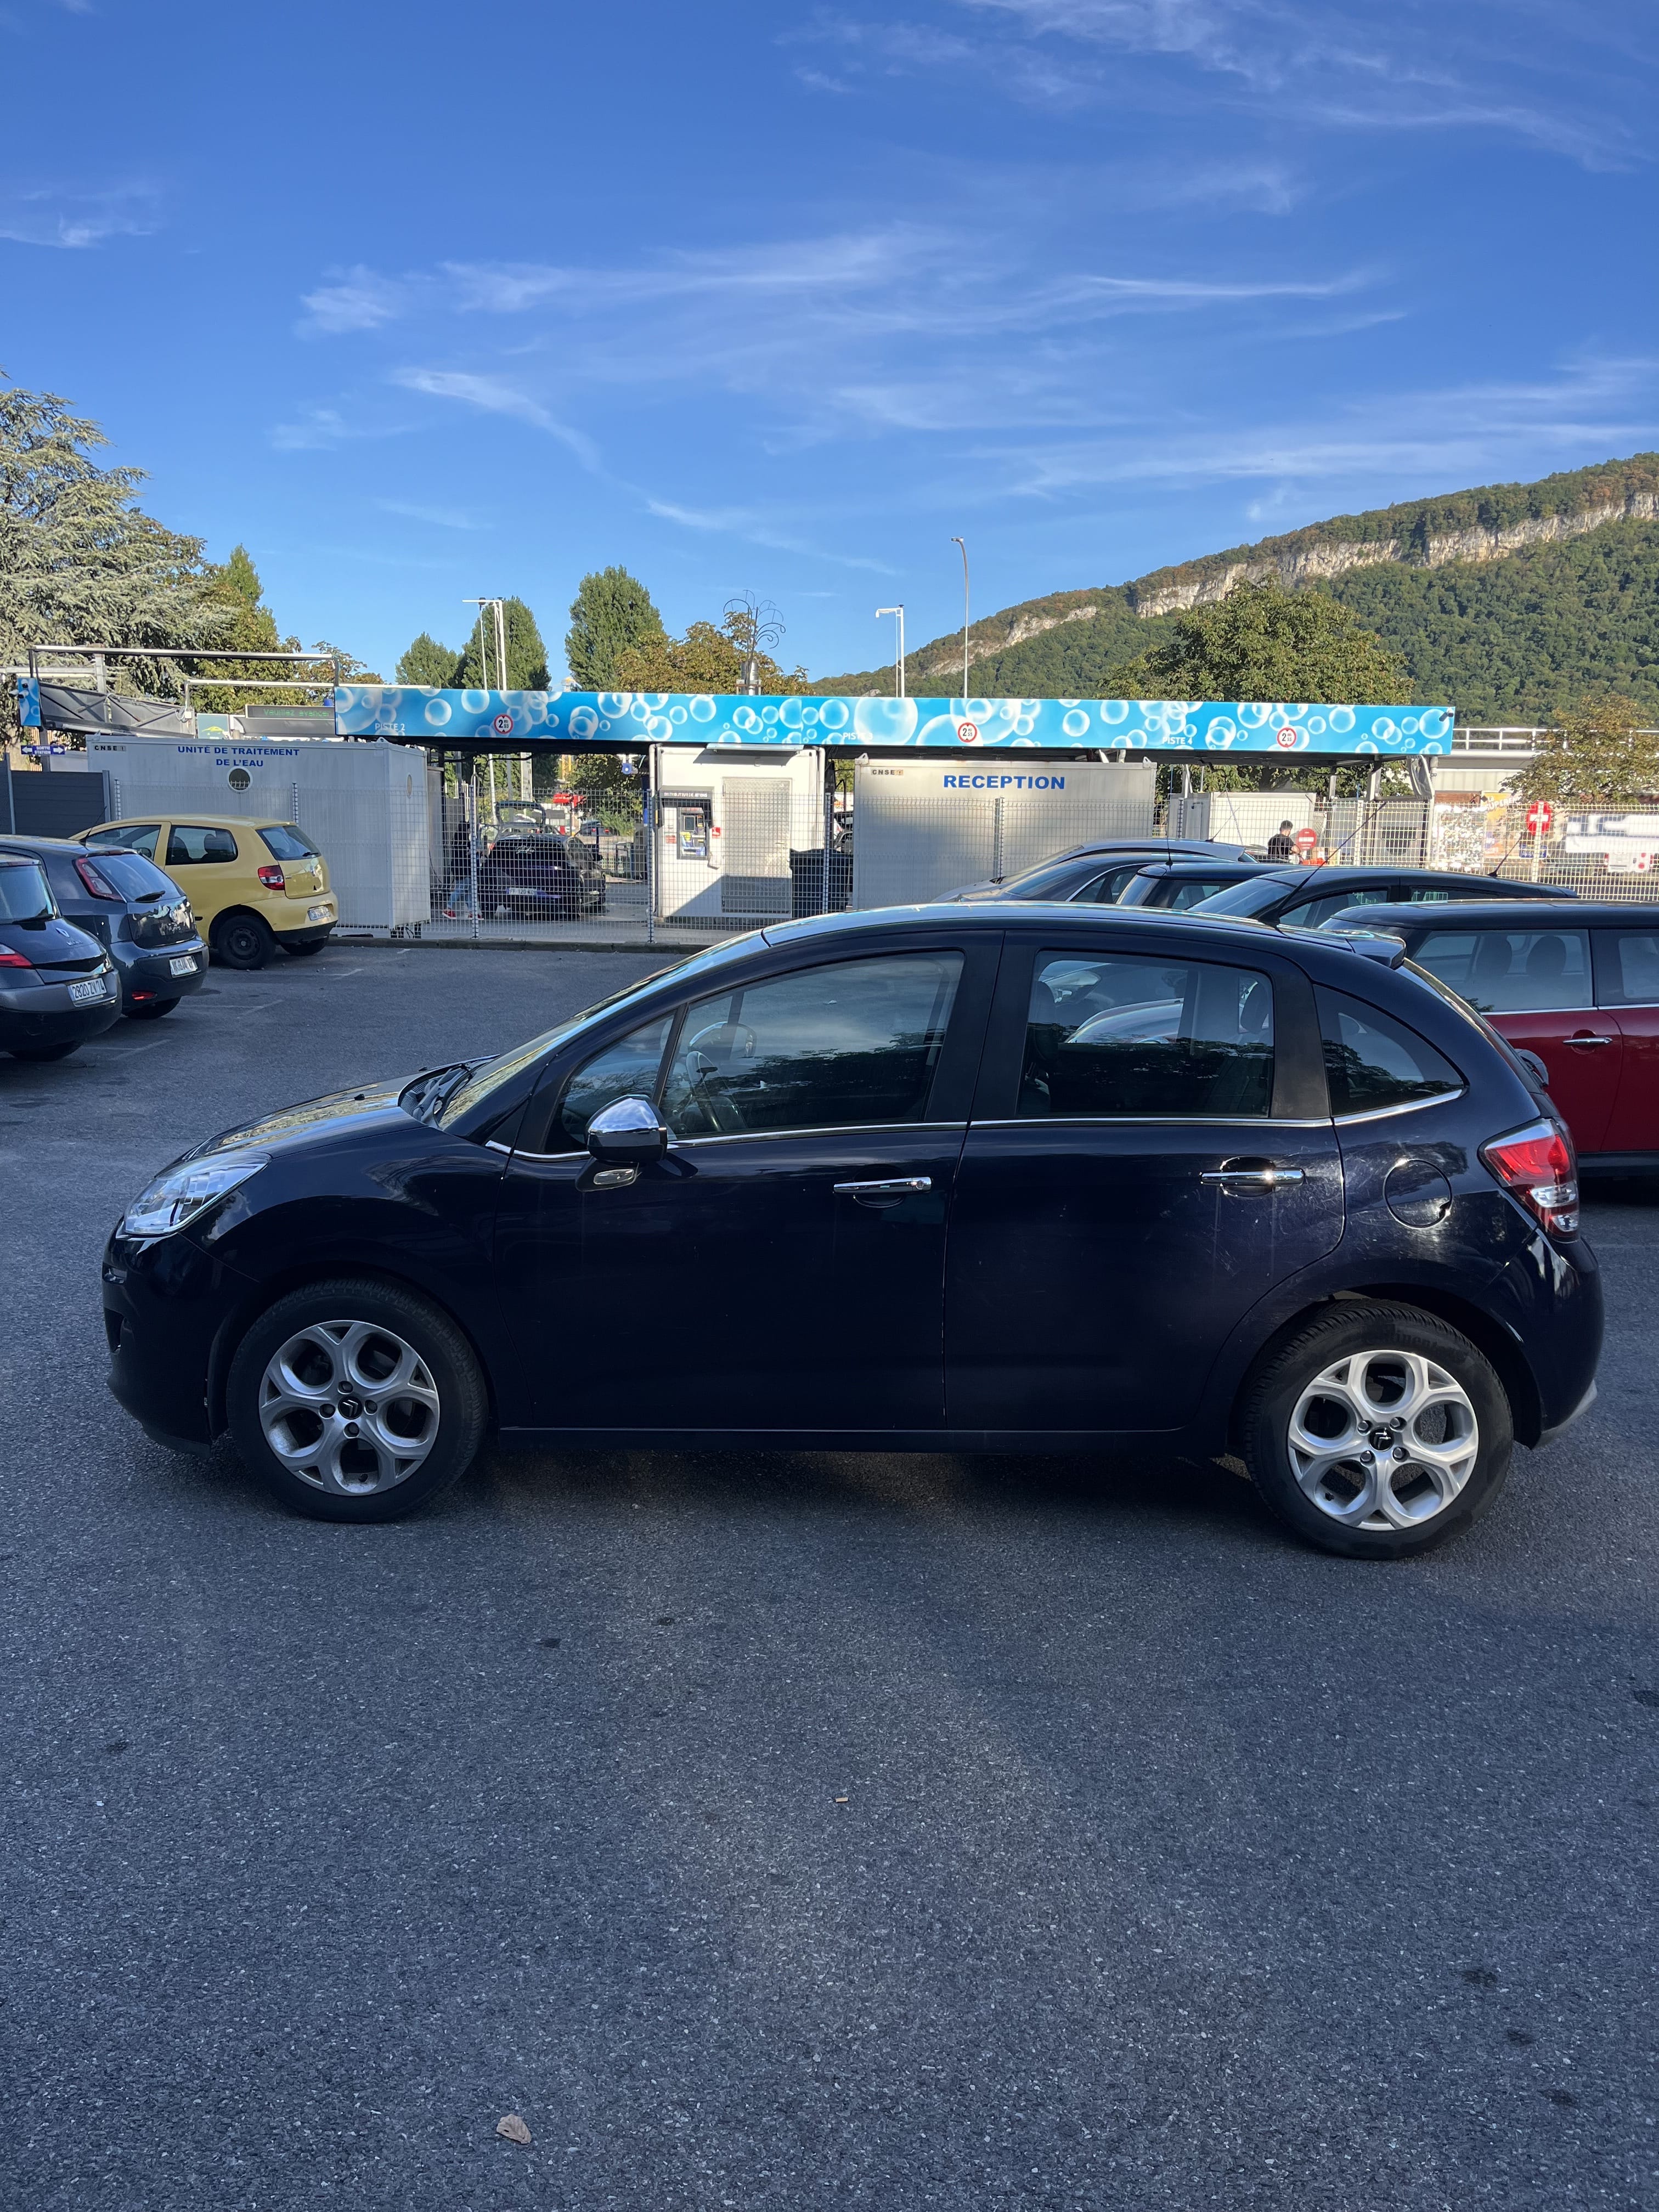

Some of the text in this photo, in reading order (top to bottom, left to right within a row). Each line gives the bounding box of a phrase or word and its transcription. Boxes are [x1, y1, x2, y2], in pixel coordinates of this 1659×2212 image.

[178, 746, 211, 754] UNITÉ
[944, 775, 1065, 790] RECEPTION
[72, 983, 89, 998] 2820
[95, 980, 105, 992] 74
